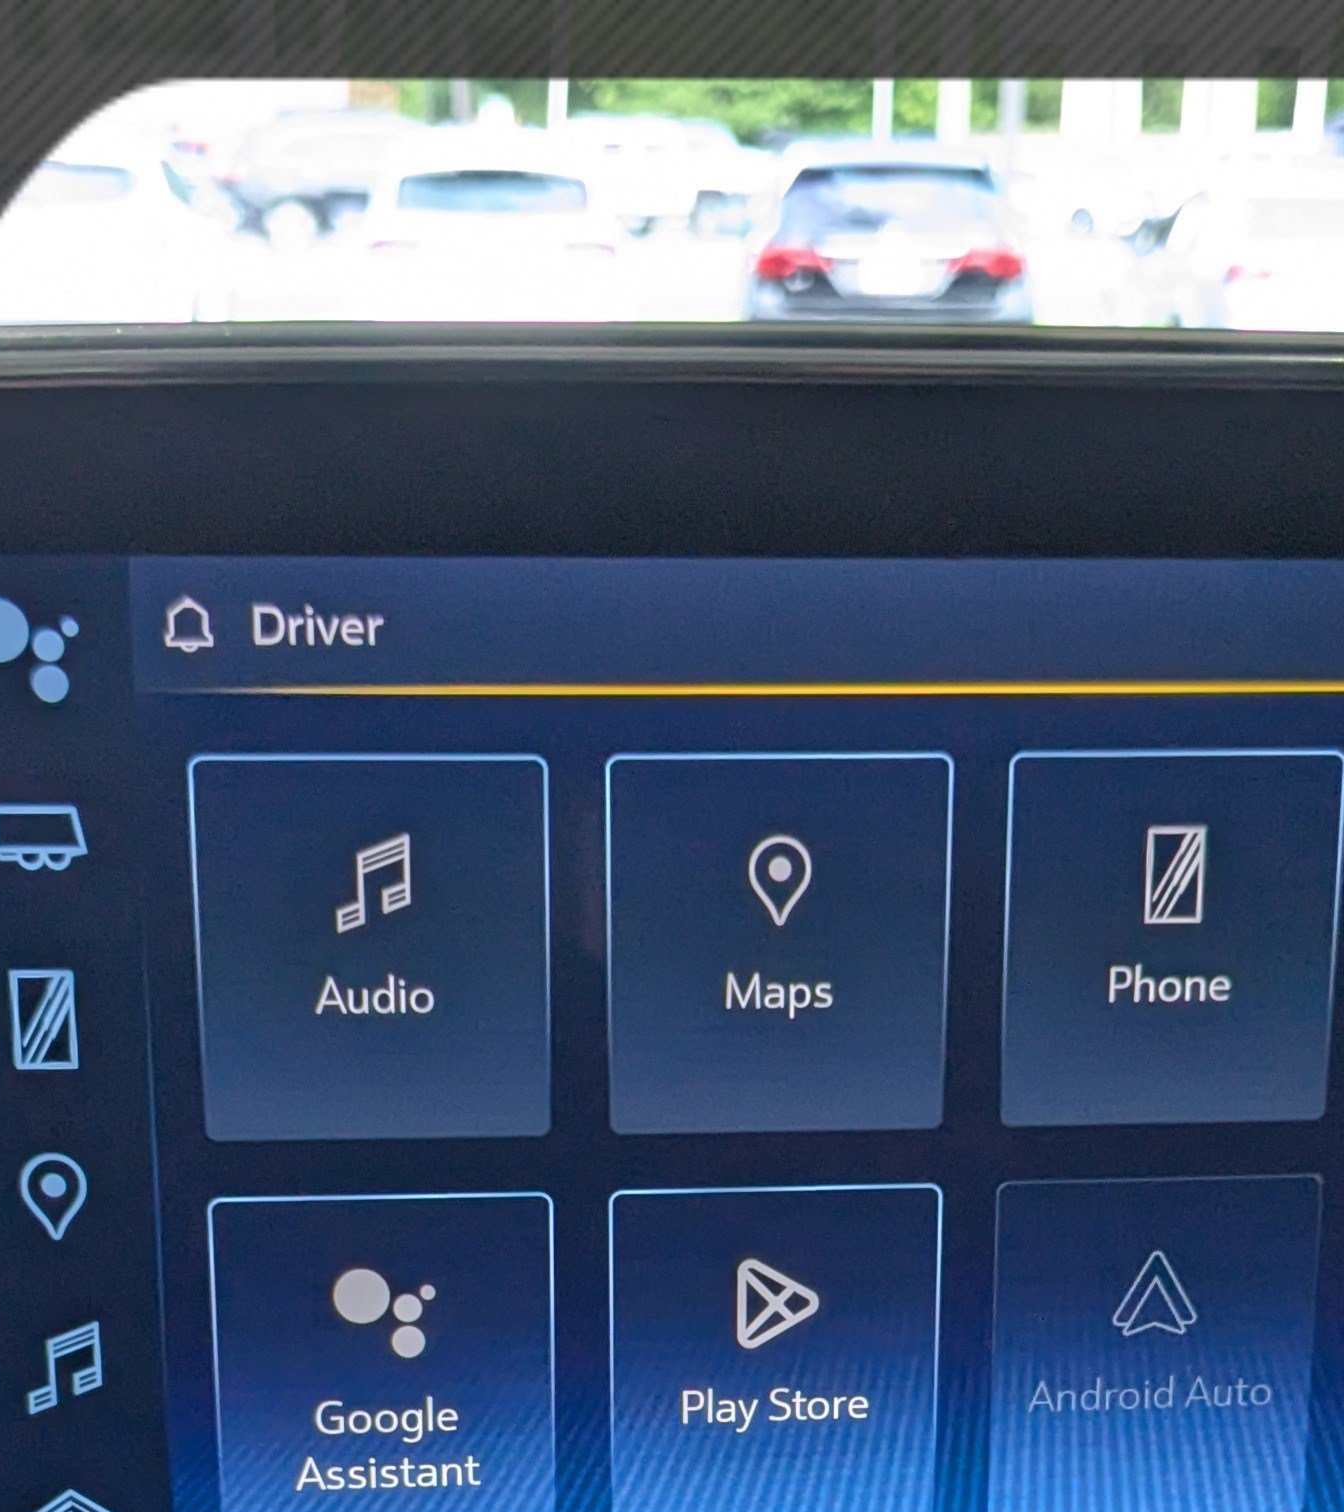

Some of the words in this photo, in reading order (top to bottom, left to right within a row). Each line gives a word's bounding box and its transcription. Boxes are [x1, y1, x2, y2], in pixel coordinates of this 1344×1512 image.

[251, 603, 386, 647] Driver
[313, 972, 436, 1016] Audio
[724, 971, 835, 1021] Maps
[1107, 962, 1233, 1005] Phone
[680, 1386, 759, 1434] Play
[767, 1386, 871, 1423] Store
[1026, 1374, 1176, 1415] Android
[1184, 1375, 1273, 1409] Auto
[313, 1394, 460, 1445] Google
[294, 1454, 483, 1493] Assistant
